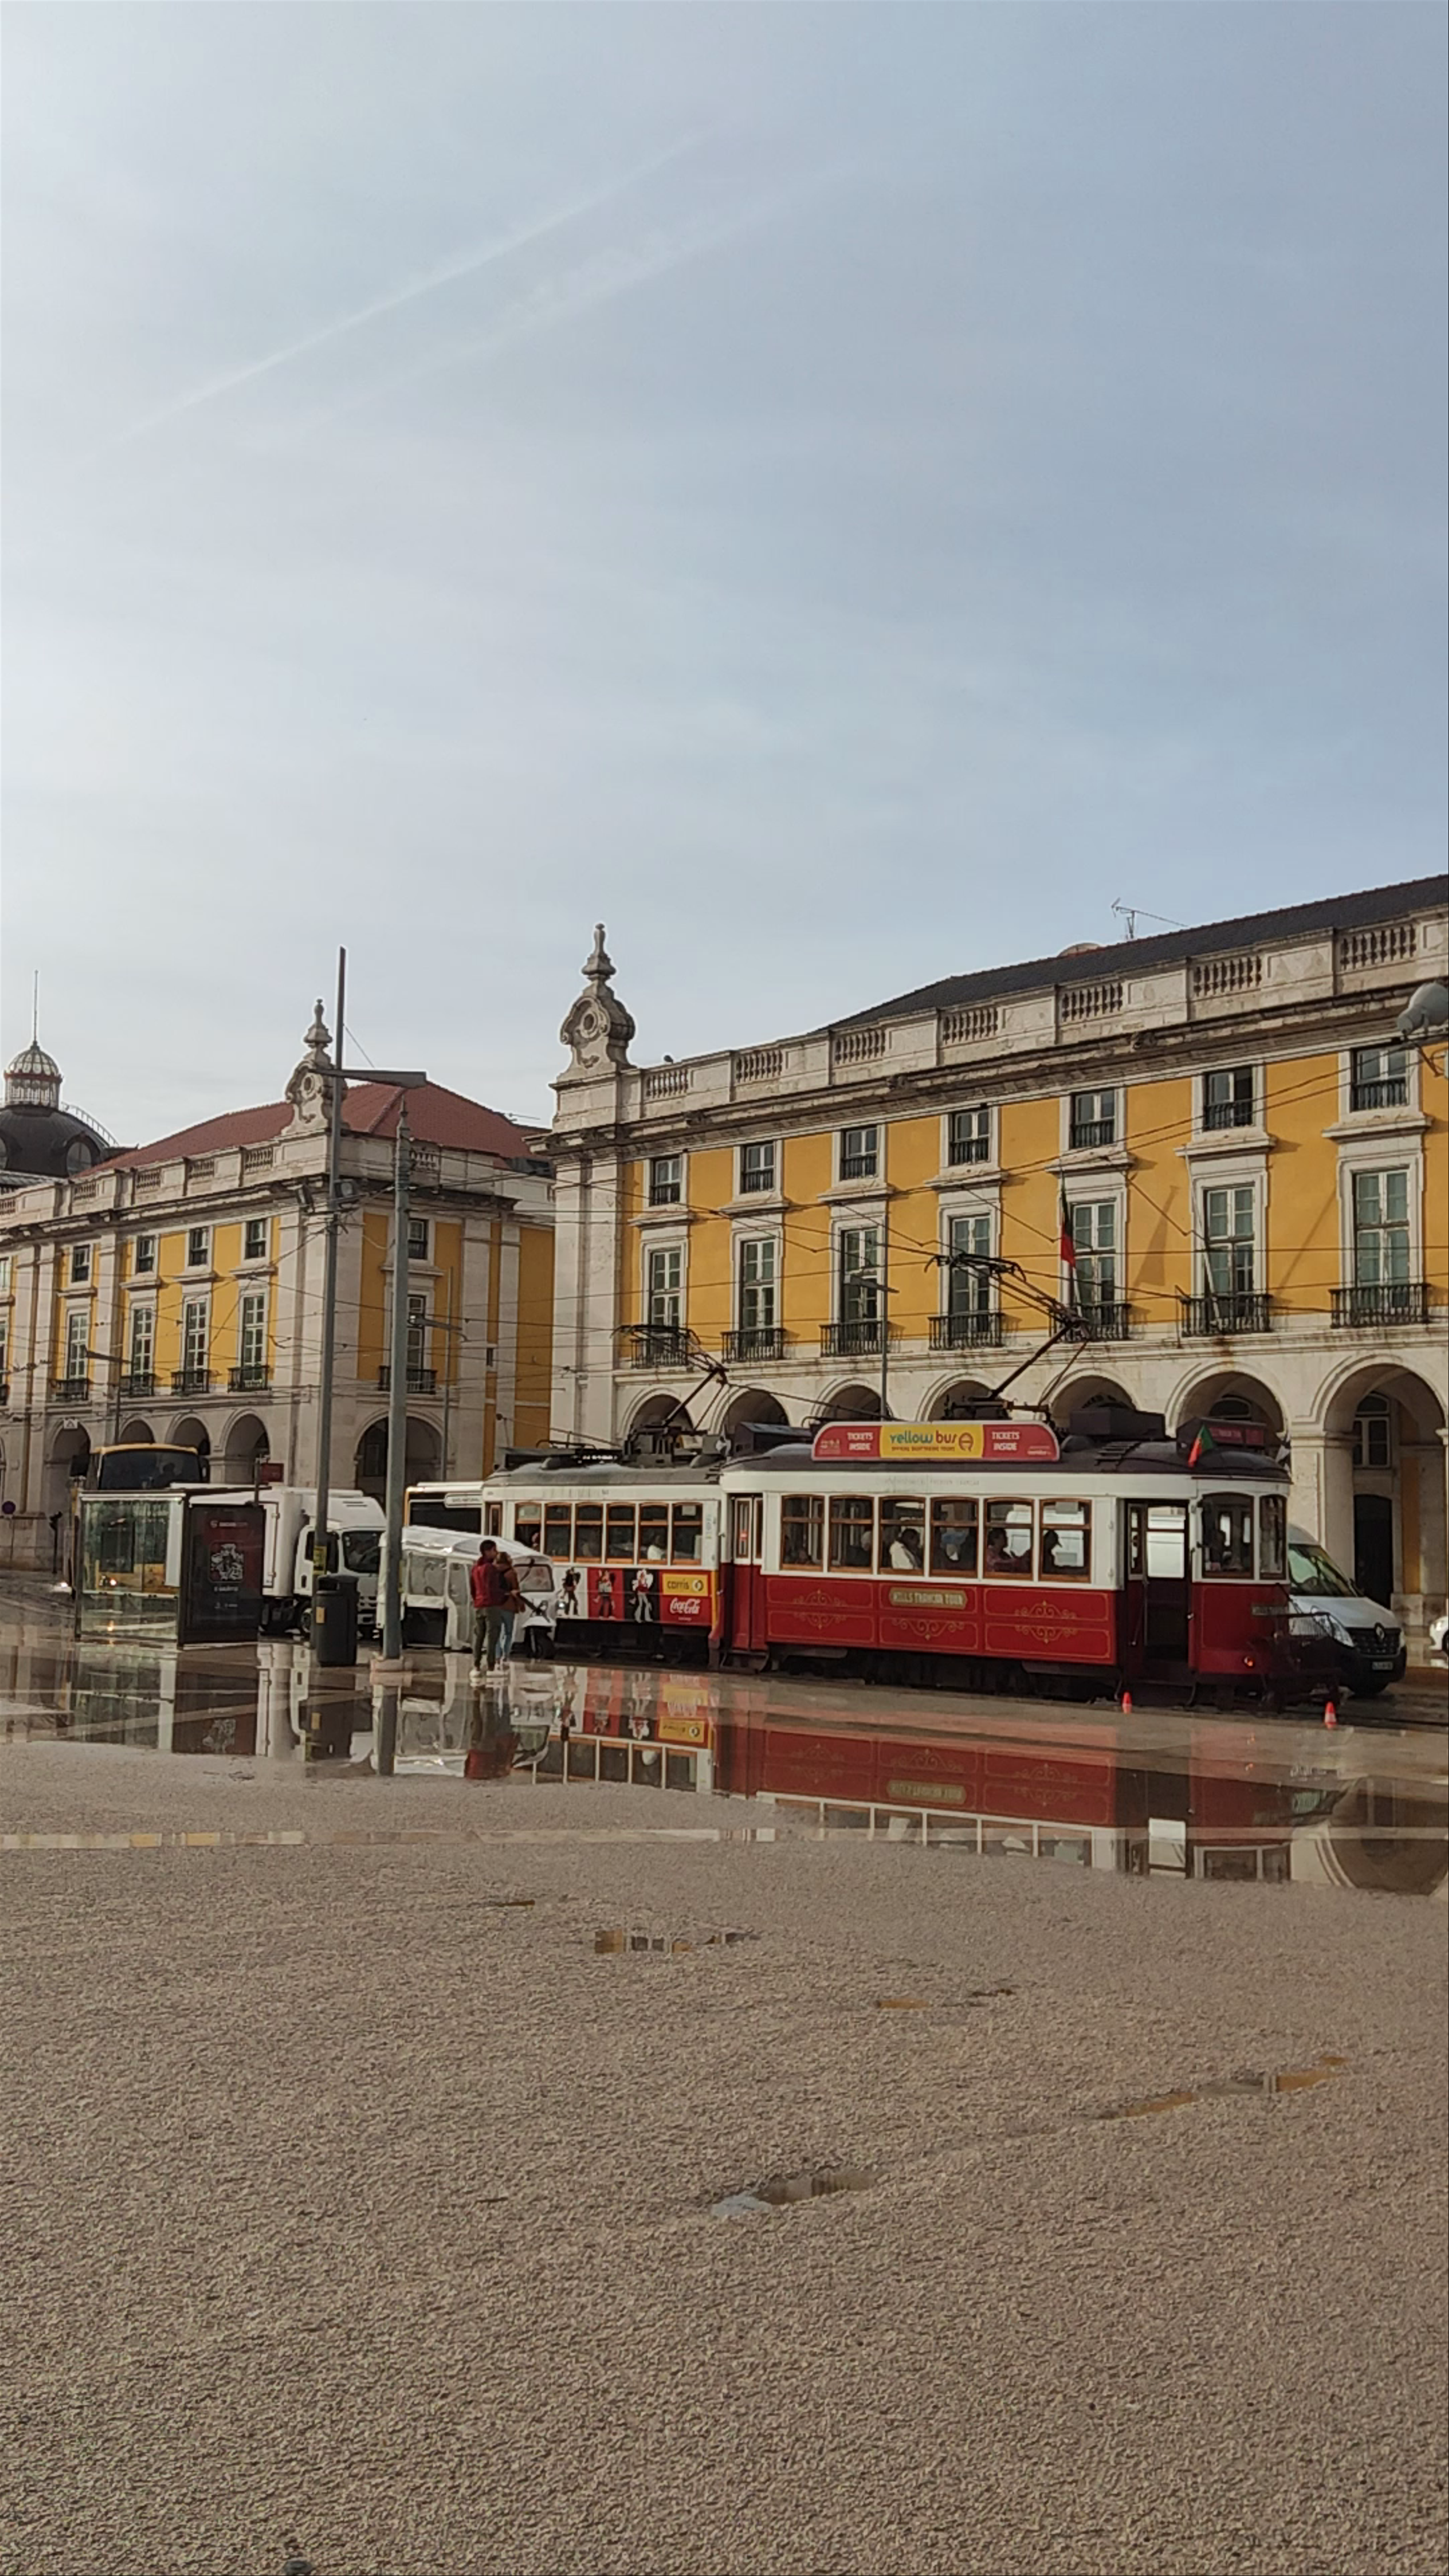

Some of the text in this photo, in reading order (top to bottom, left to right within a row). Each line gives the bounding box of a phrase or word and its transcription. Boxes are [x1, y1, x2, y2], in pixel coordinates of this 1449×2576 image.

[847, 1432, 874, 1441] TICKETS
[890, 1429, 957, 1444] yellow bus
[992, 1432, 1020, 1440] TICKETS
[993, 1443, 1018, 1451] INSIDE
[667, 1578, 690, 1590] carris
[892, 1592, 913, 1603] HILLS
[670, 1597, 701, 1614] Coca-Cola
